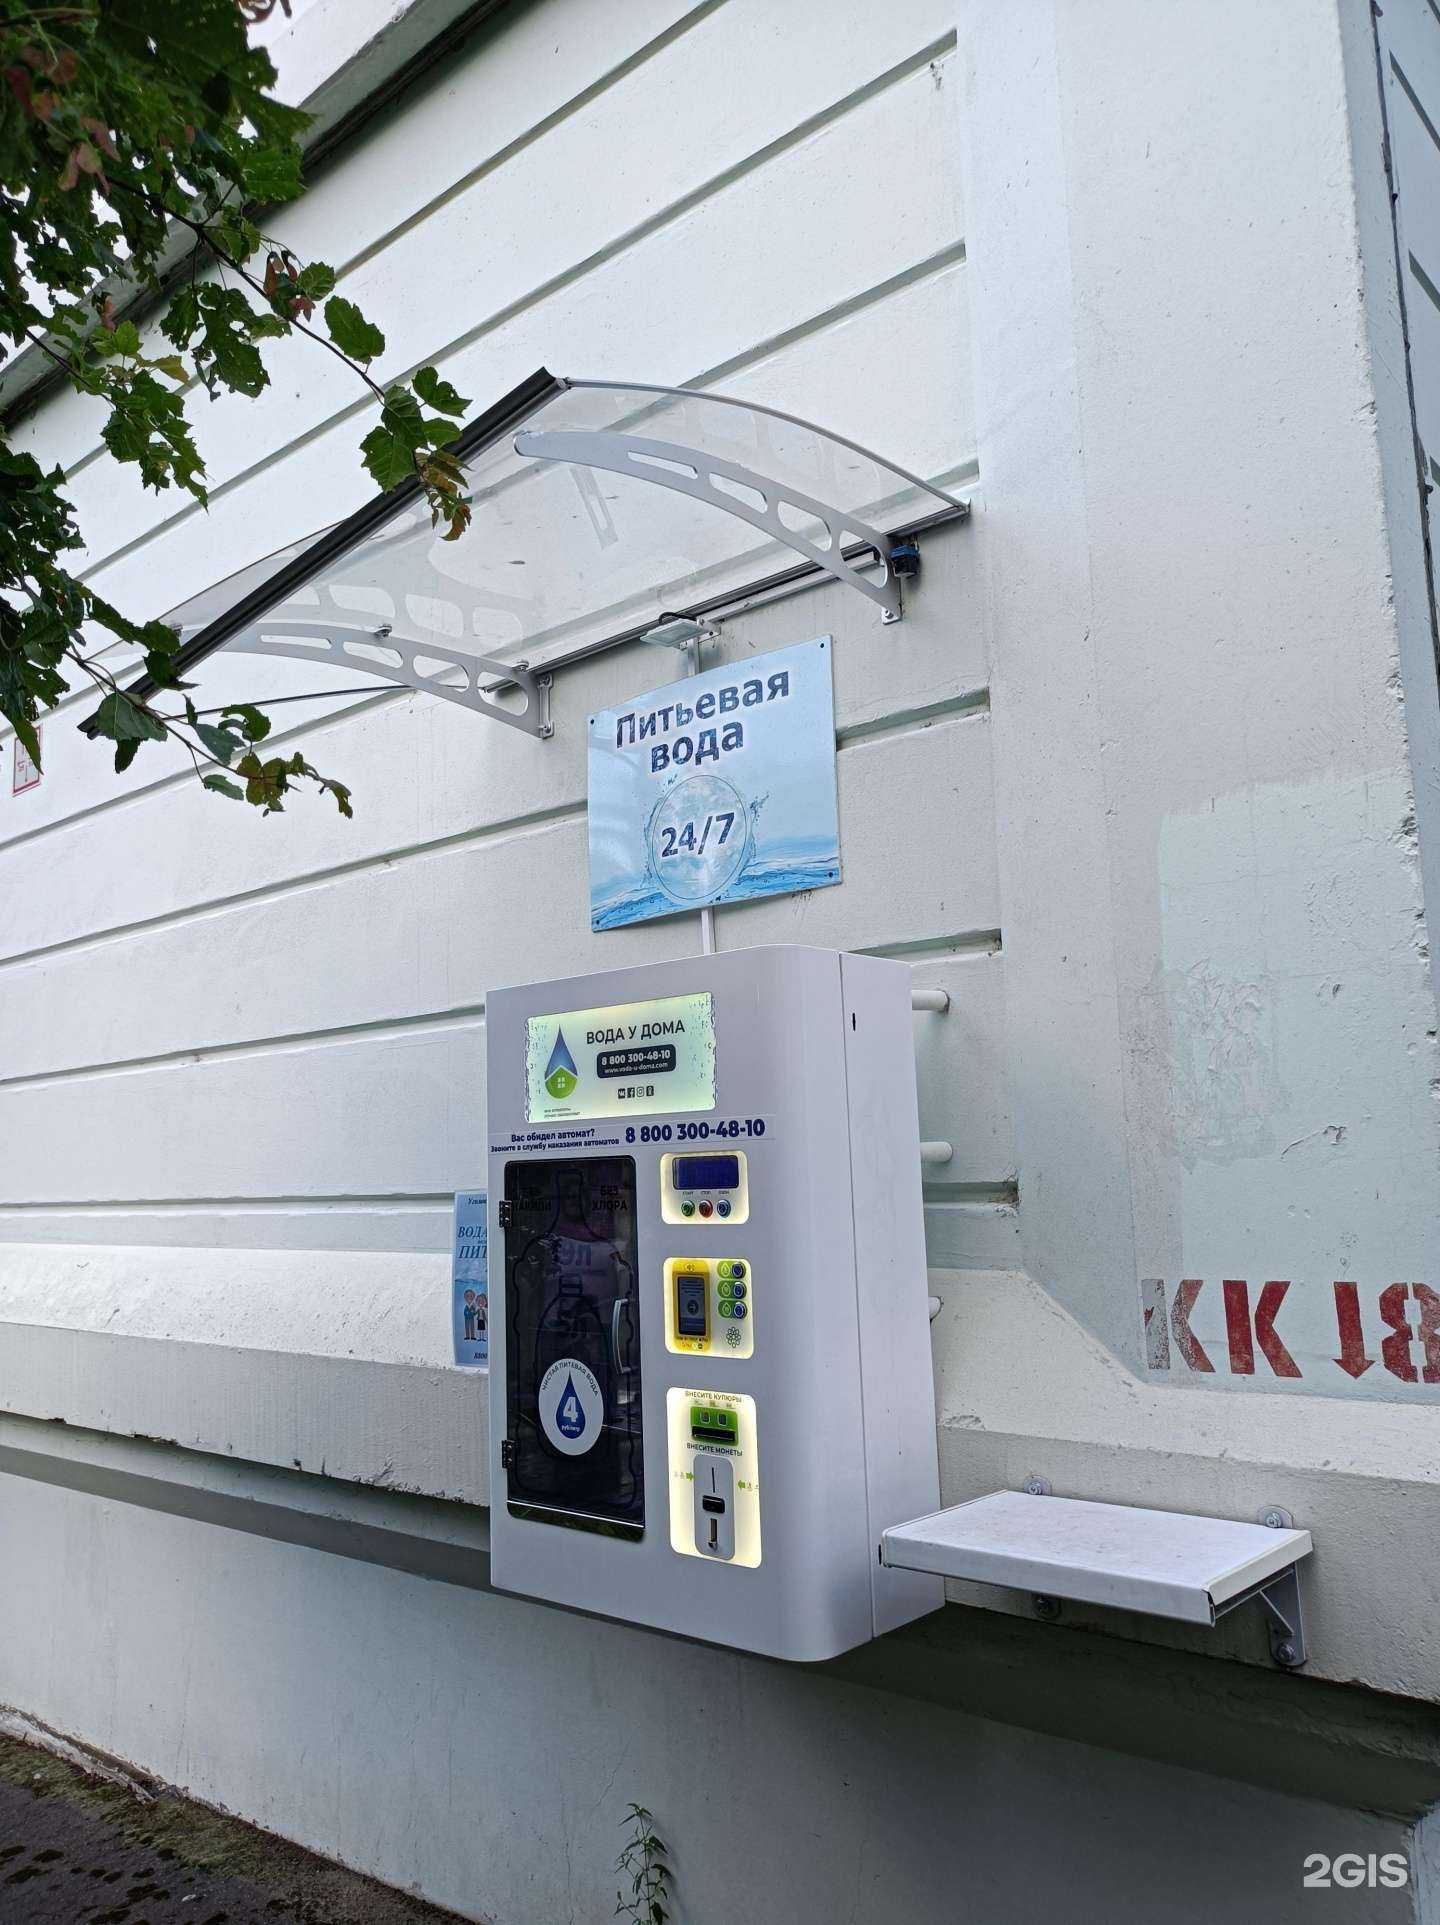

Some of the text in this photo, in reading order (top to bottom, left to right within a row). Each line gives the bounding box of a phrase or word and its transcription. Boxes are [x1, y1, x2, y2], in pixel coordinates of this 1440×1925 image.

[616, 671, 789, 749] Питьевая
[651, 721, 743, 773] вода
[661, 812, 735, 857] 24/7
[586, 1019, 685, 1045] ВОДА У ДОМА
[601, 1049, 671, 1066] 8 800 300-48-10
[511, 1128, 596, 1143] Вас обидел автомат?
[625, 1118, 766, 1143] 8 800 300-48-10
[563, 1396, 578, 1423] 4
